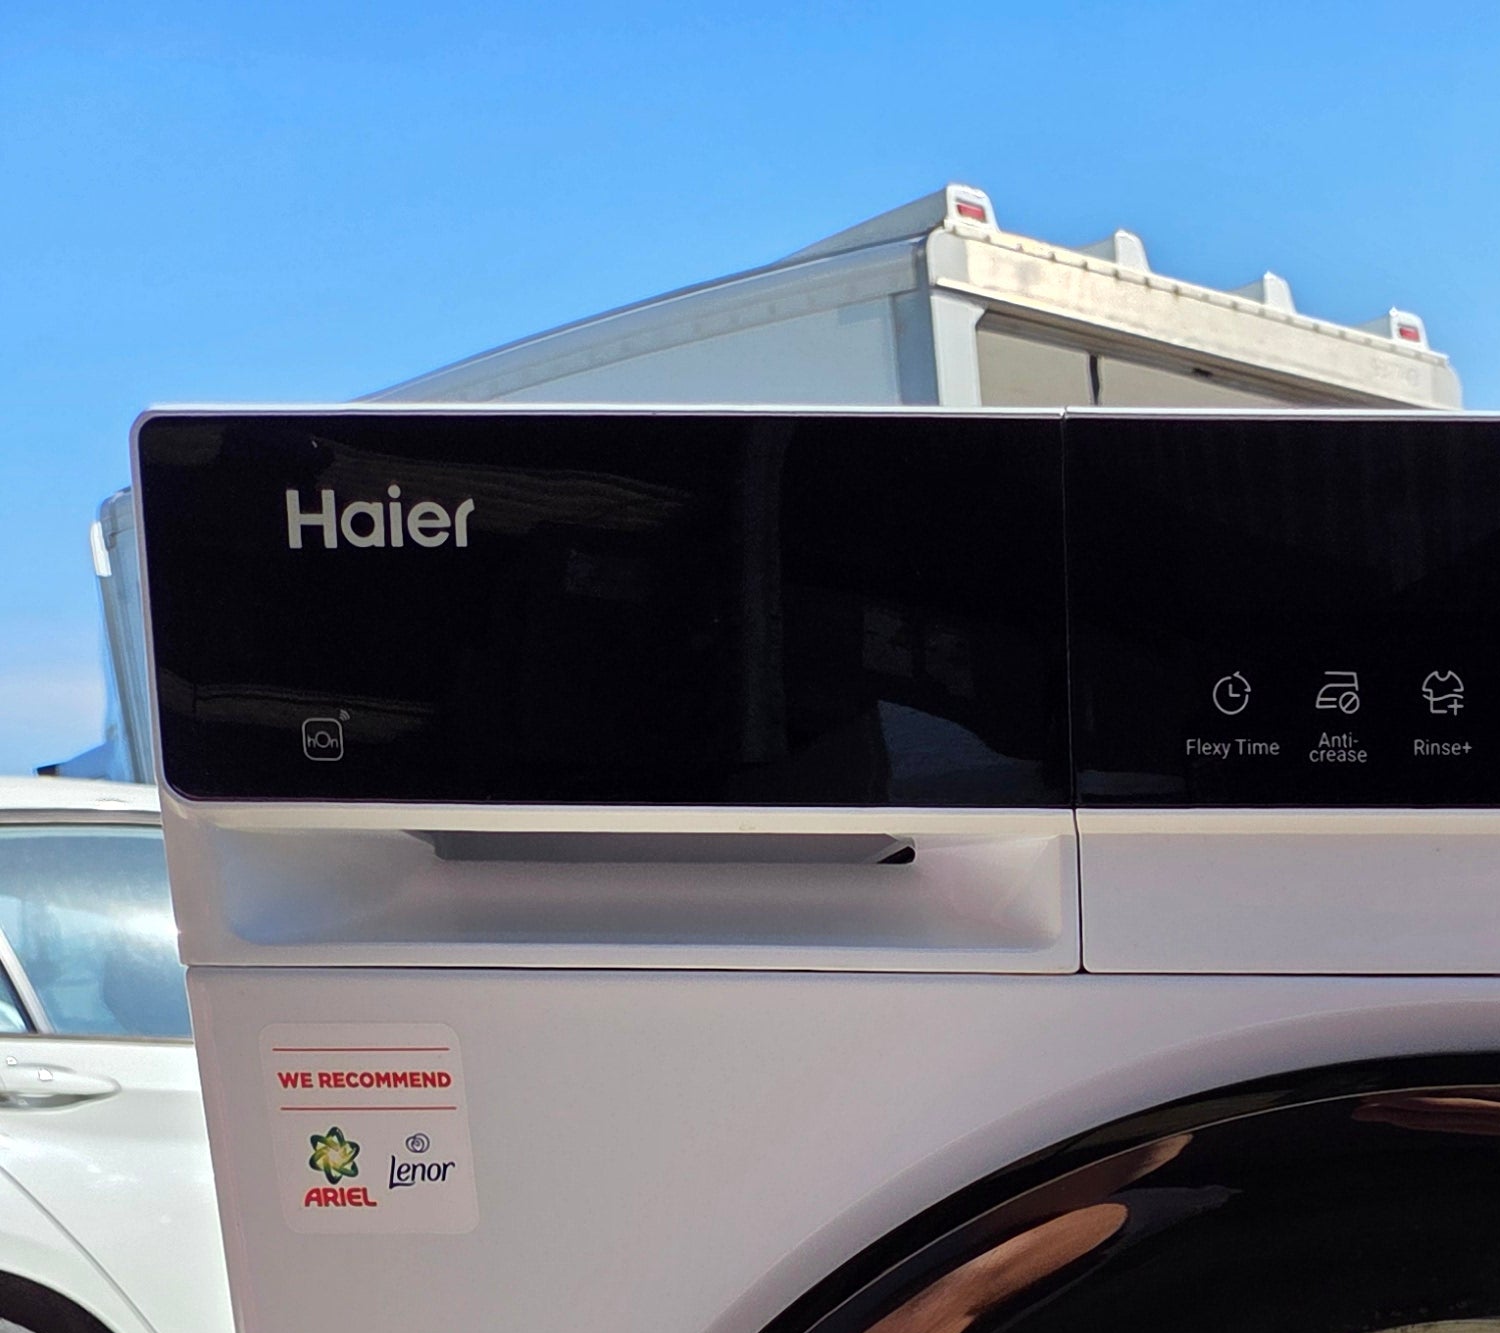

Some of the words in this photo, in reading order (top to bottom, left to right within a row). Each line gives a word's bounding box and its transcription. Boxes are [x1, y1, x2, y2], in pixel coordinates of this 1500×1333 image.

[286, 485, 474, 548] Haier
[1187, 738, 1231, 759] Flexy
[1235, 739, 1279, 755] Time
[1318, 732, 1359, 749] Anti-
[1414, 739, 1472, 755] Rinse+
[1309, 750, 1367, 763] crease
[278, 1072, 313, 1088] WE
[318, 1072, 451, 1088] RECOMMEND
[389, 1155, 455, 1189] Lenor
[305, 1188, 377, 1207] ARIEL
